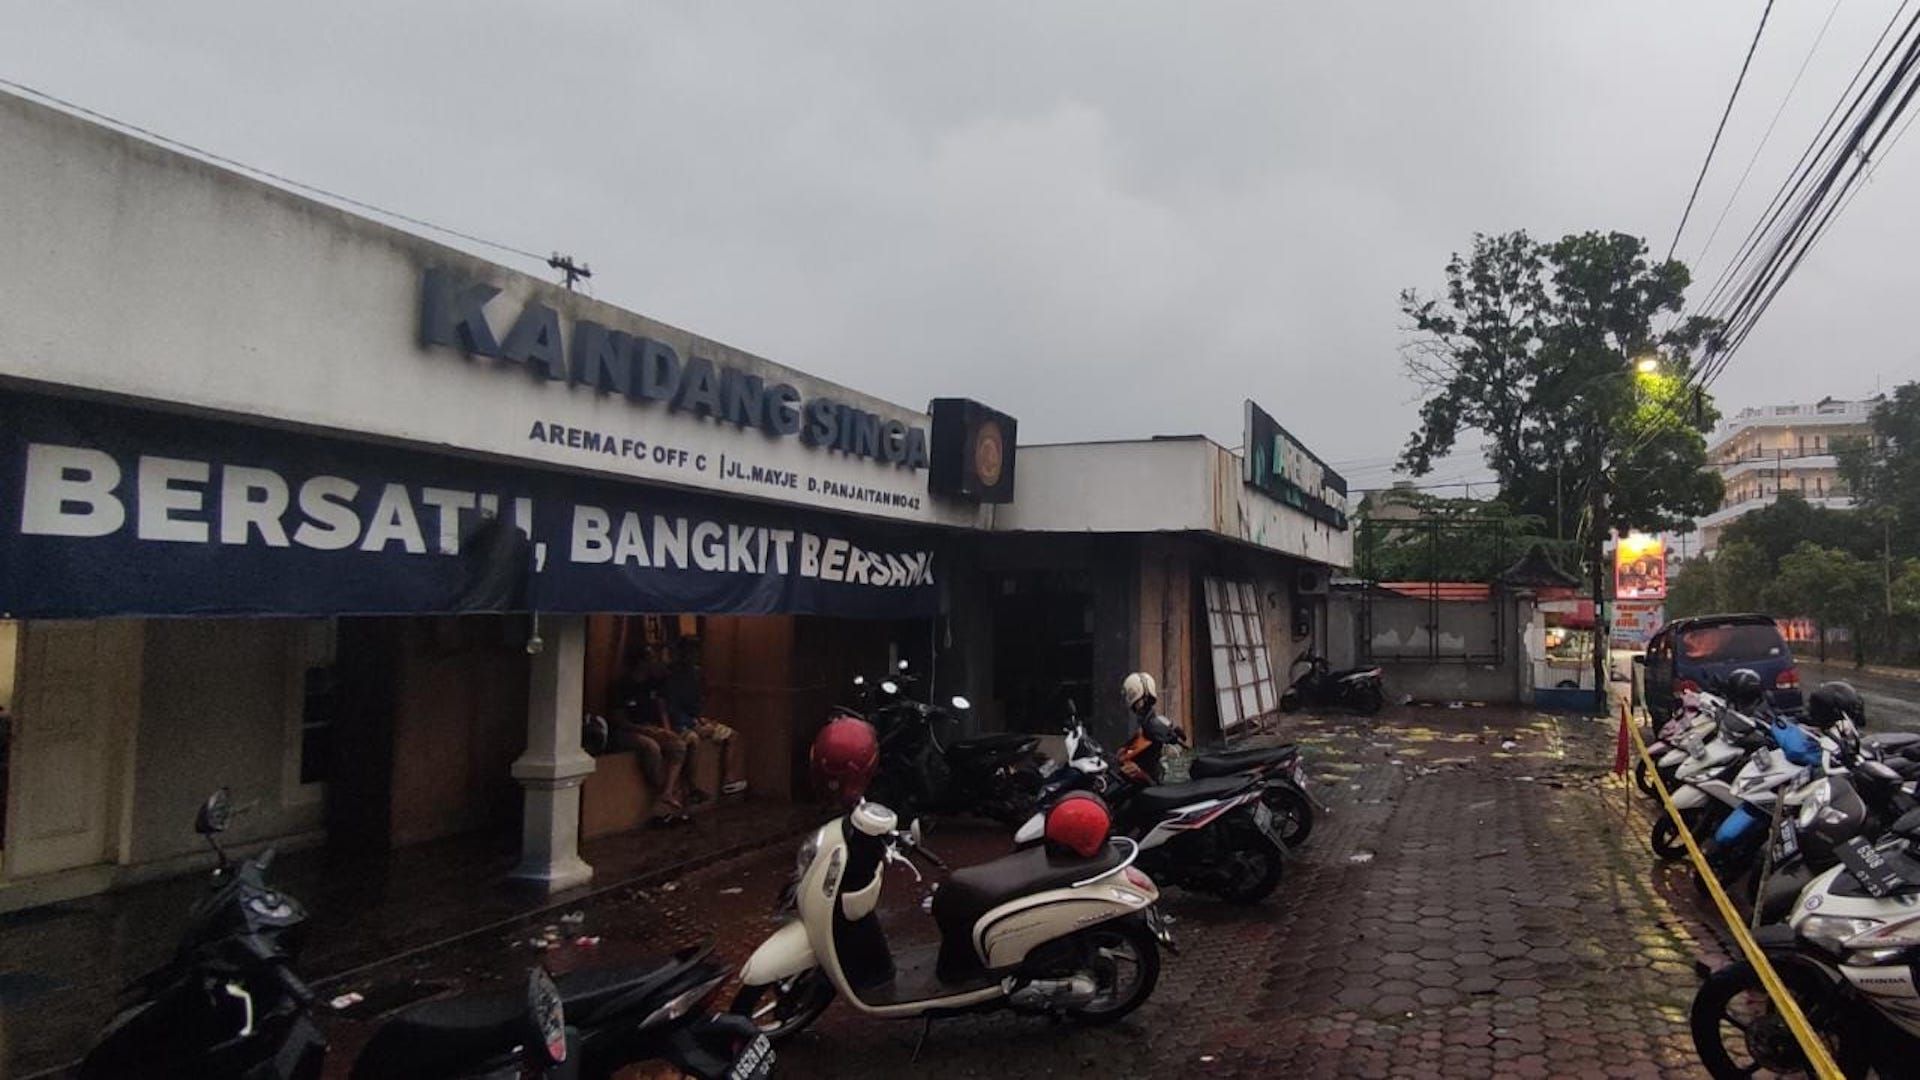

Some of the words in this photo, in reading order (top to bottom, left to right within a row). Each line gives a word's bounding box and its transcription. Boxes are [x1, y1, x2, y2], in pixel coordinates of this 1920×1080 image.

[419, 267, 801, 436] KANDANG
[803, 398, 930, 469] SINGA
[529, 420, 617, 456] AREMA
[621, 439, 647, 460] FC
[570, 504, 795, 575] BANGKIT
